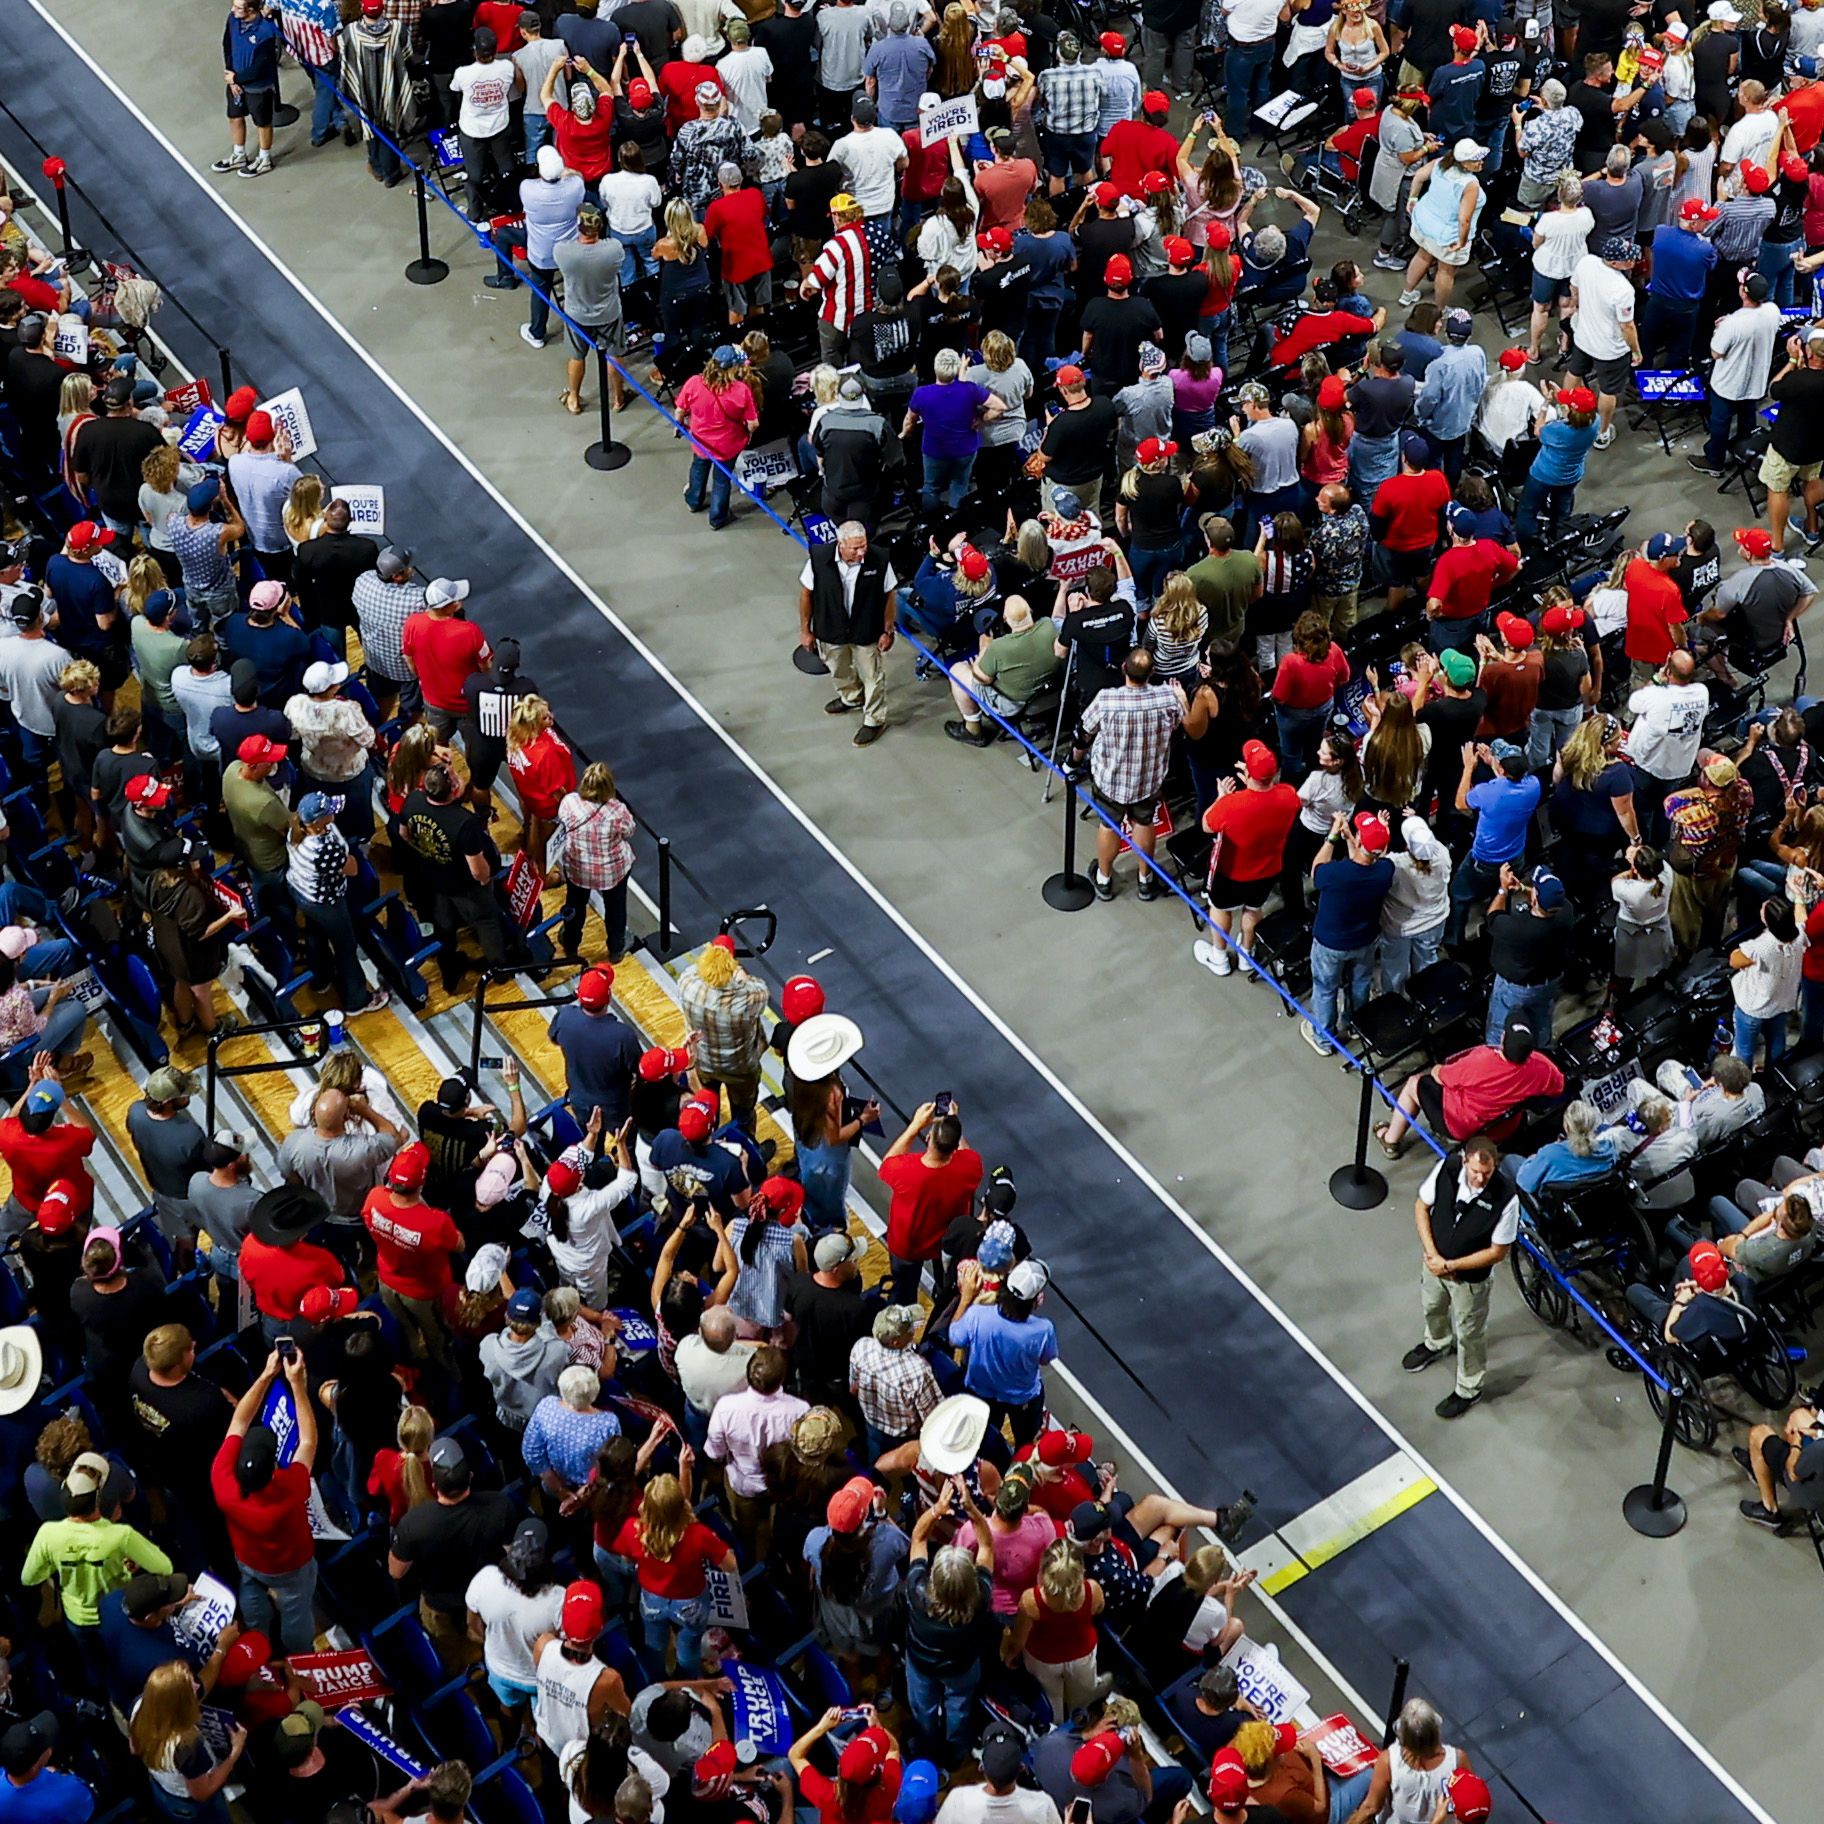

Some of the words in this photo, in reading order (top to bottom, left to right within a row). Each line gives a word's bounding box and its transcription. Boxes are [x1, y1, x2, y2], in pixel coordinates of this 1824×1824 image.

[925, 114, 971, 137] FIRED!
[927, 107, 966, 125] YOU'RE
[179, 412, 215, 454] TRUMP
[742, 453, 784, 470] YOU'RE
[350, 509, 380, 522] IRED!
[1056, 552, 1107, 568] TRUMP
[1082, 613, 1123, 627] FINISHER
[1672, 701, 1705, 709] WANTED
[297, 1662, 373, 1681] TRUMP
[1237, 1655, 1288, 1704] YOU'RE
[737, 1665, 757, 1747] TRUMP
[753, 1674, 773, 1744] VANCE
[1237, 1677, 1281, 1726] RED!
[348, 1711, 422, 1771] TRUMP
[1316, 1726, 1365, 1753] RUMP
